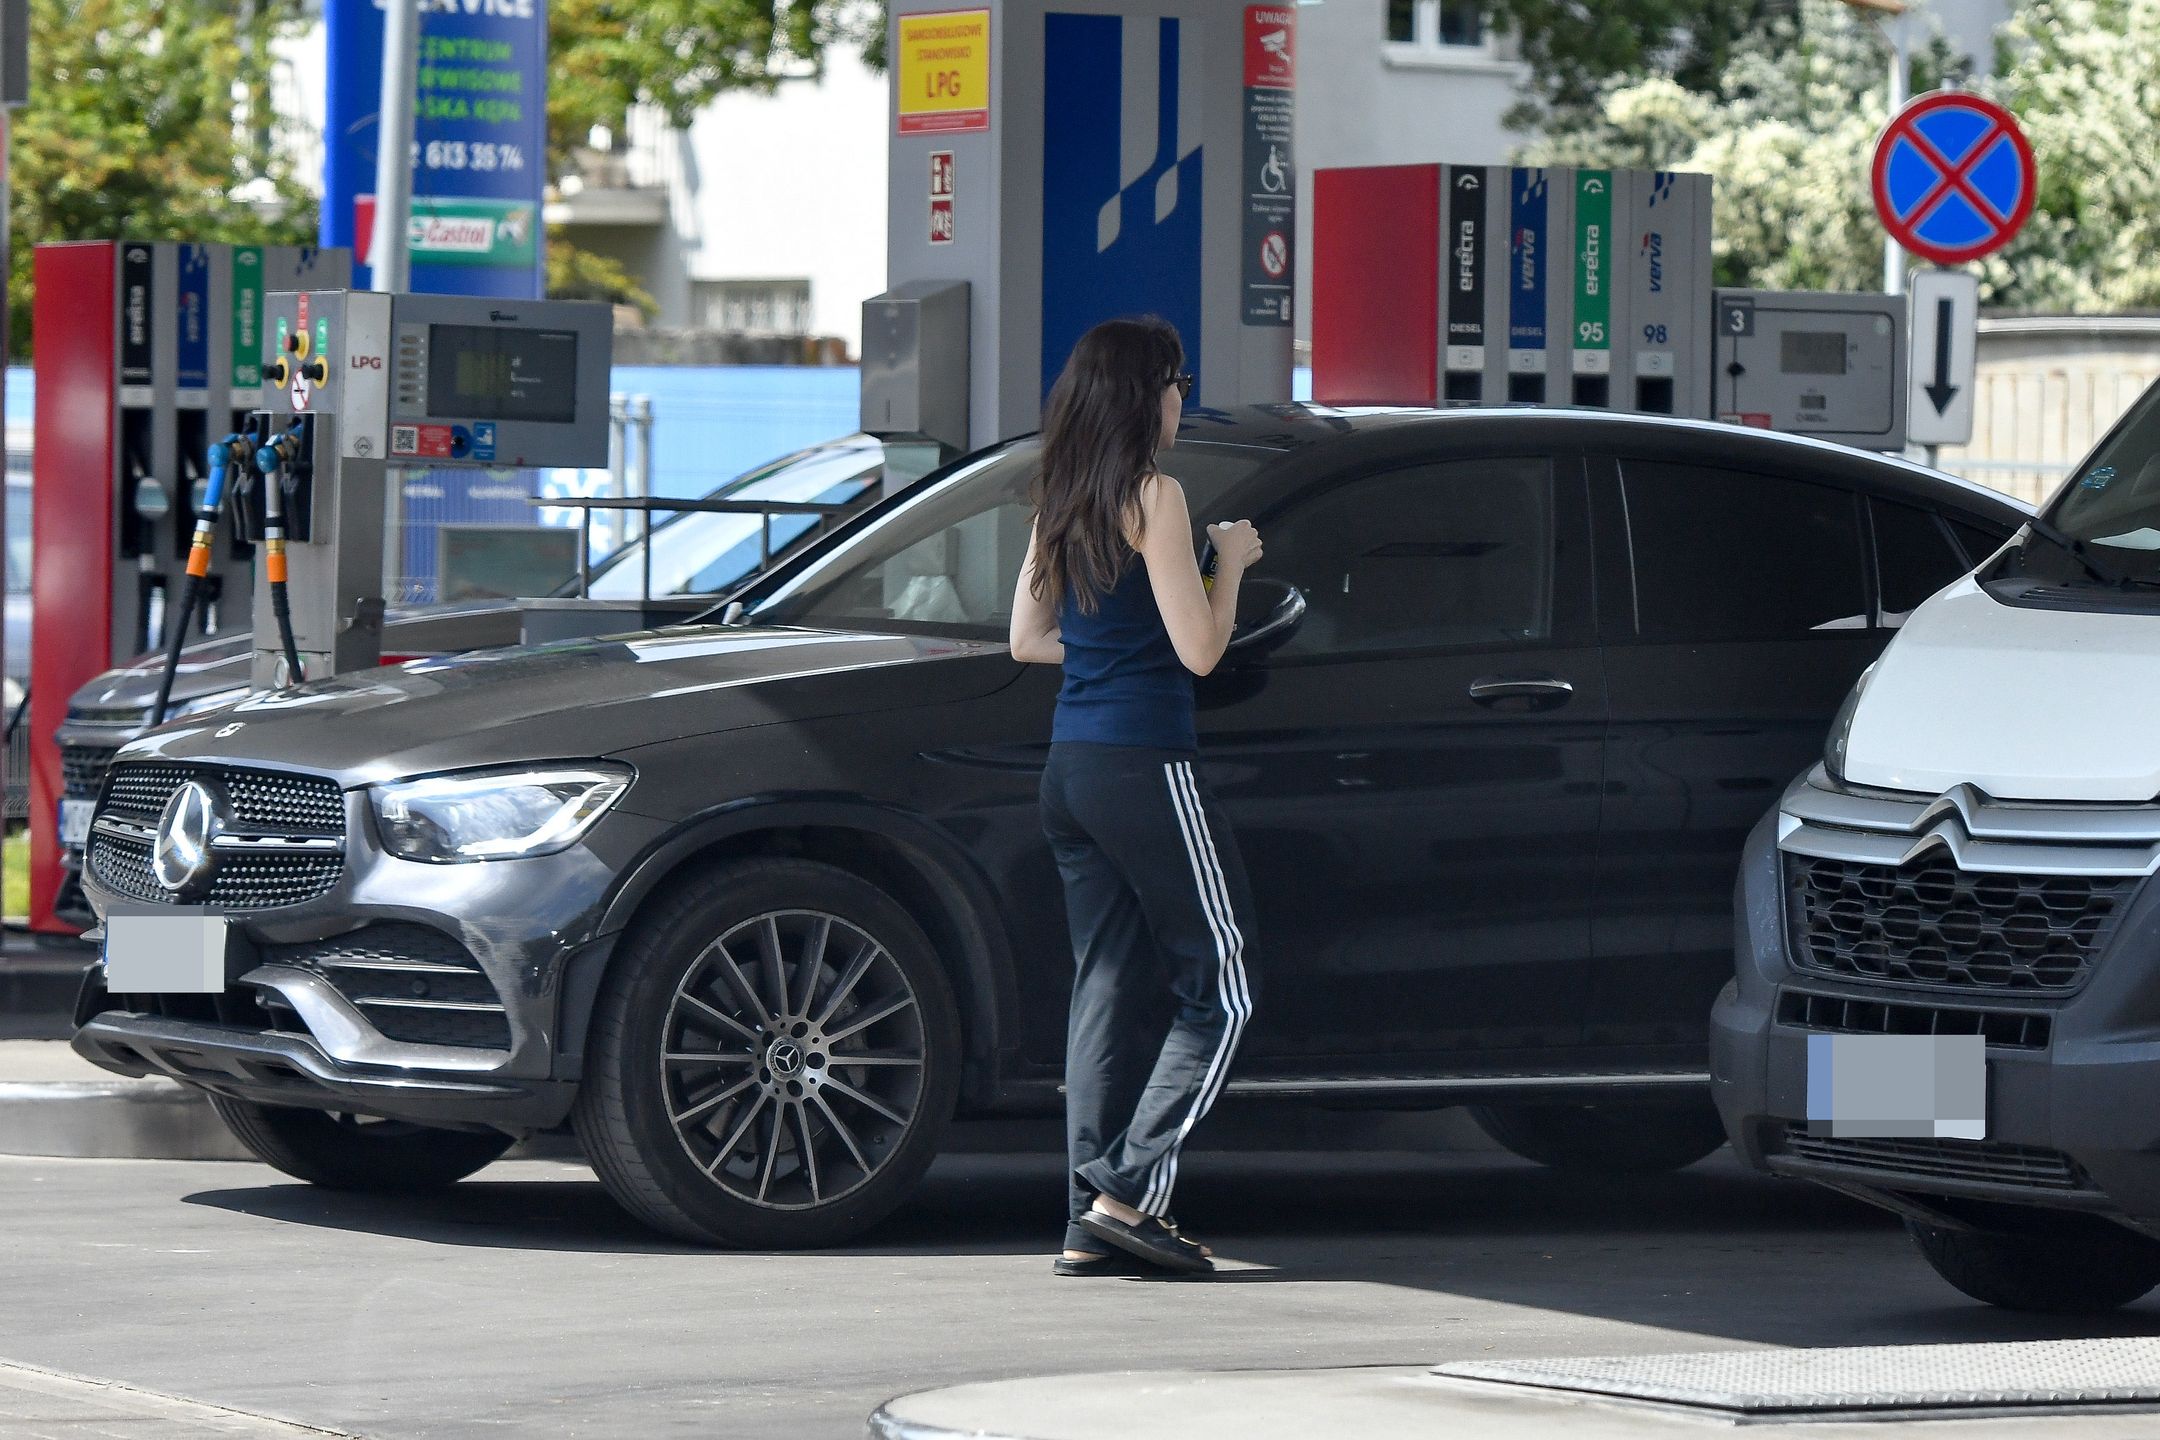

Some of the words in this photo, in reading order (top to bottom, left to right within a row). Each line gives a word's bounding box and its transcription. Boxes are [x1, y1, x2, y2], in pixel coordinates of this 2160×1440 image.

[926, 71, 961, 98] LPG
[426, 140, 468, 170] 613
[427, 220, 487, 245] Castrol
[1649, 232, 1663, 293] verva
[1450, 323, 1482, 333] DIESEL
[1730, 309, 1745, 332] 3
[1511, 326, 1543, 337] DIESEL
[1579, 322, 1604, 342] 95
[1643, 324, 1668, 343] 98
[352, 355, 382, 370] LPG
